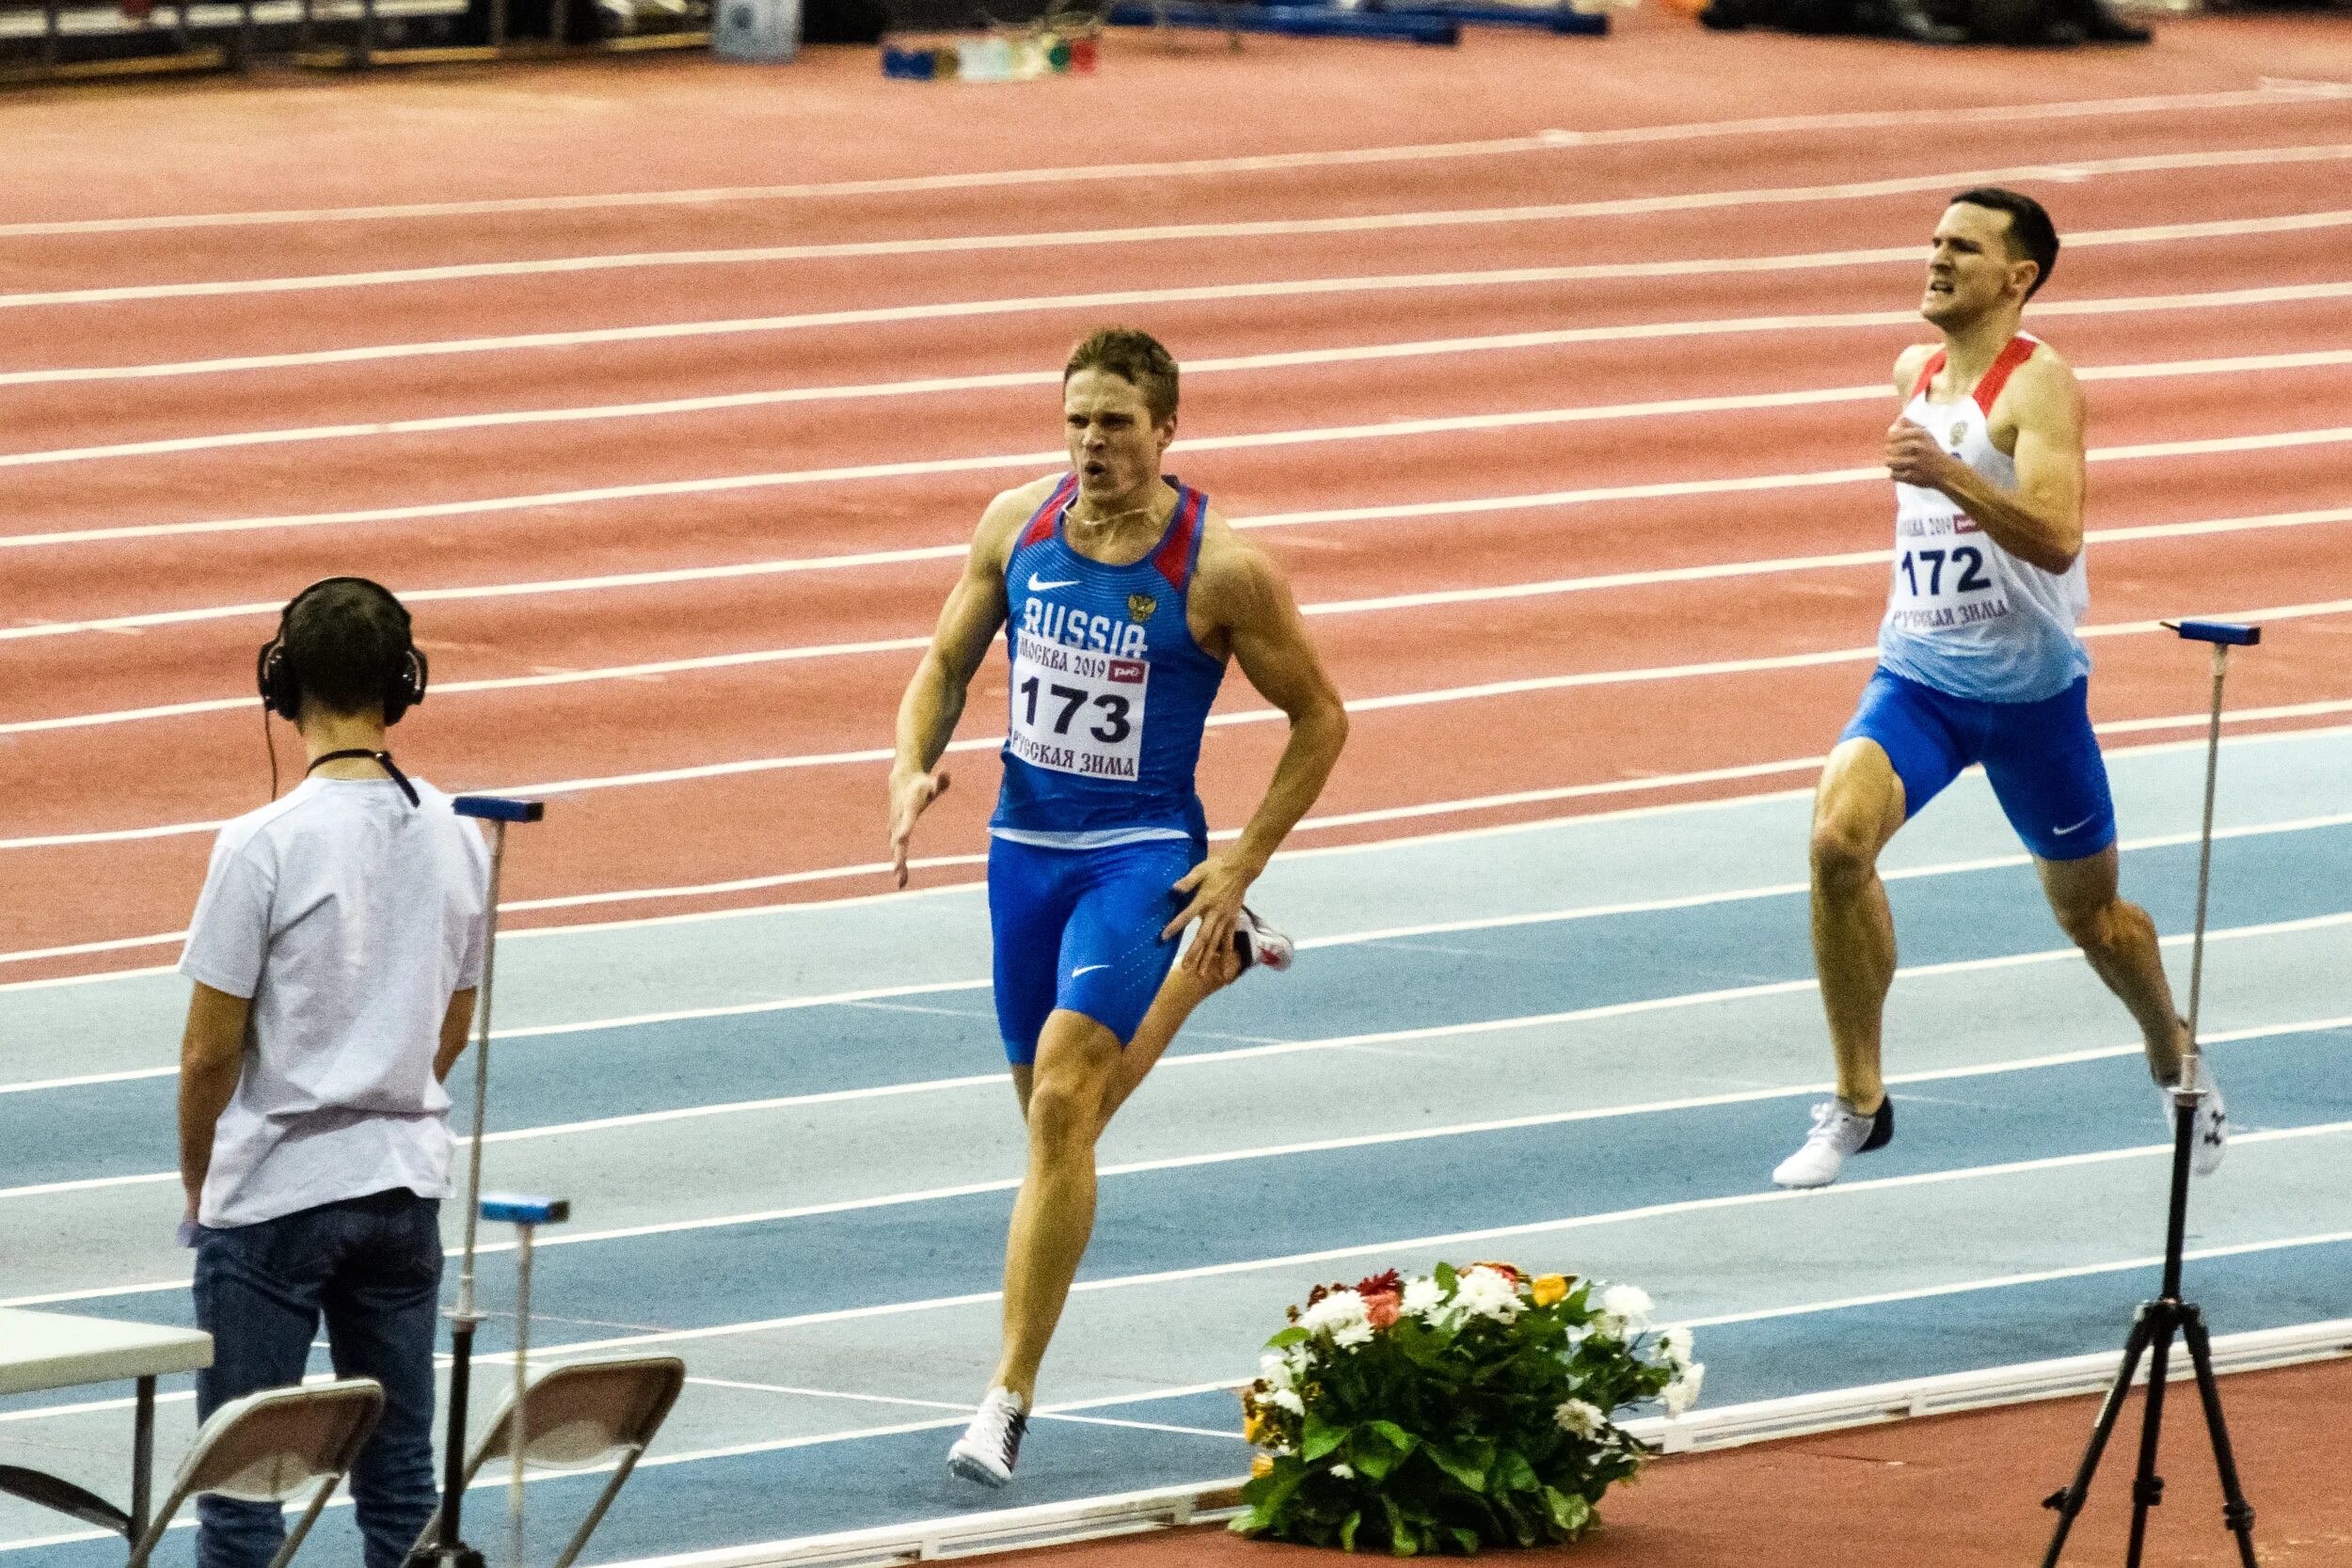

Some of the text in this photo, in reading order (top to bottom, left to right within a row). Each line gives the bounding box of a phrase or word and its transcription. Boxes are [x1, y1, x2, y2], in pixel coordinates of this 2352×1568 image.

[1901, 546, 1992, 596] 172
[1024, 596, 1149, 658] RUSSIA
[1019, 636, 1106, 678] МОСКВА 2019
[1021, 675, 1132, 744] 173
[1012, 730, 1136, 778] РУССКАЯ ЗИМА
